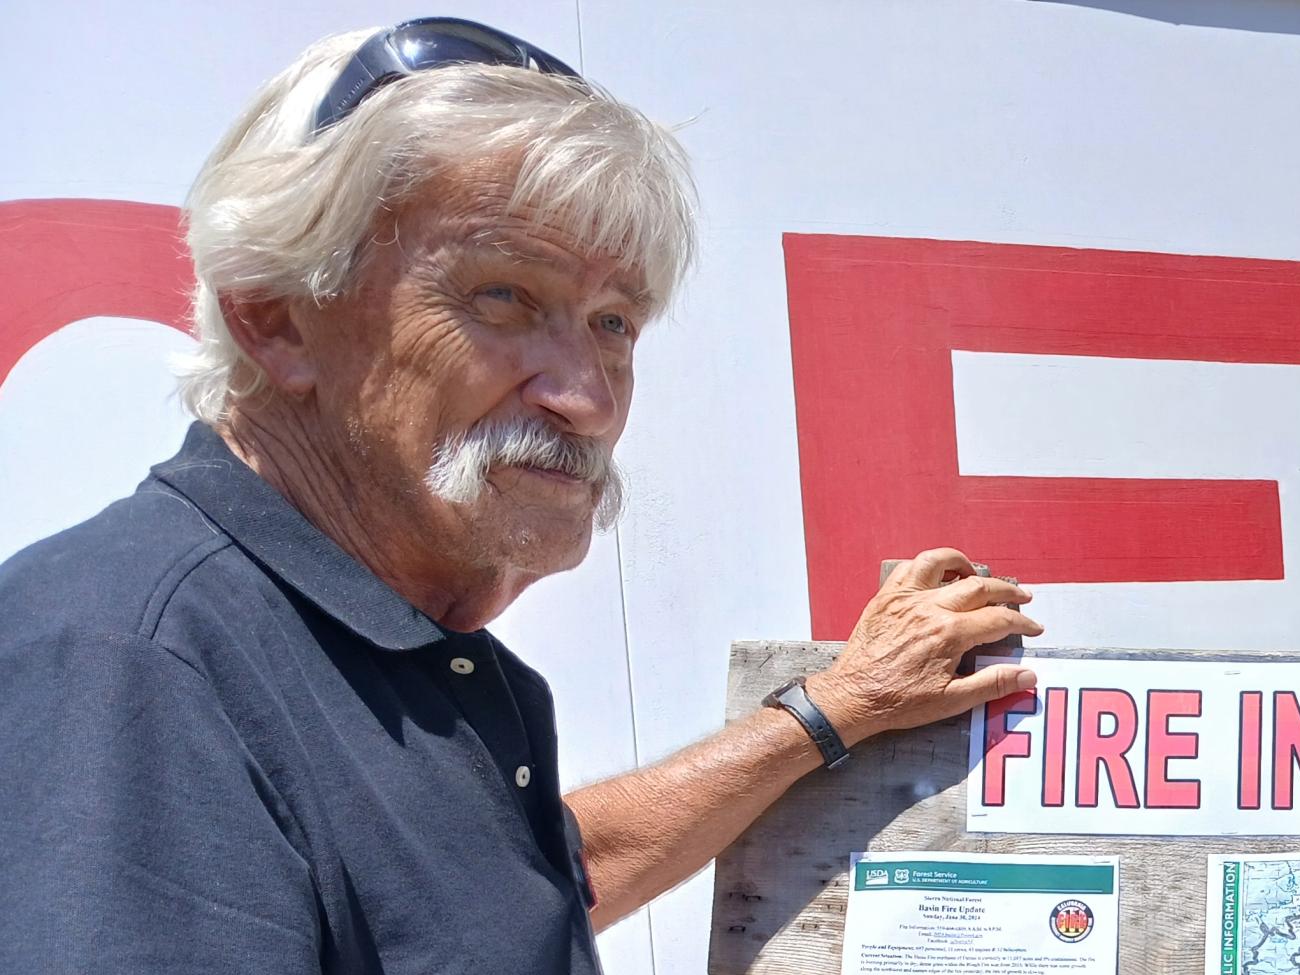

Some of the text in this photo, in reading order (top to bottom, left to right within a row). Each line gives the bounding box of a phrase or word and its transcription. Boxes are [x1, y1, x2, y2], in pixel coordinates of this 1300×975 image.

[982, 686, 1202, 810] FIRE
[866, 869, 888, 879] USDA
[912, 870, 956, 879] Forest Service
[1224, 862, 1237, 948] INFORMATION
